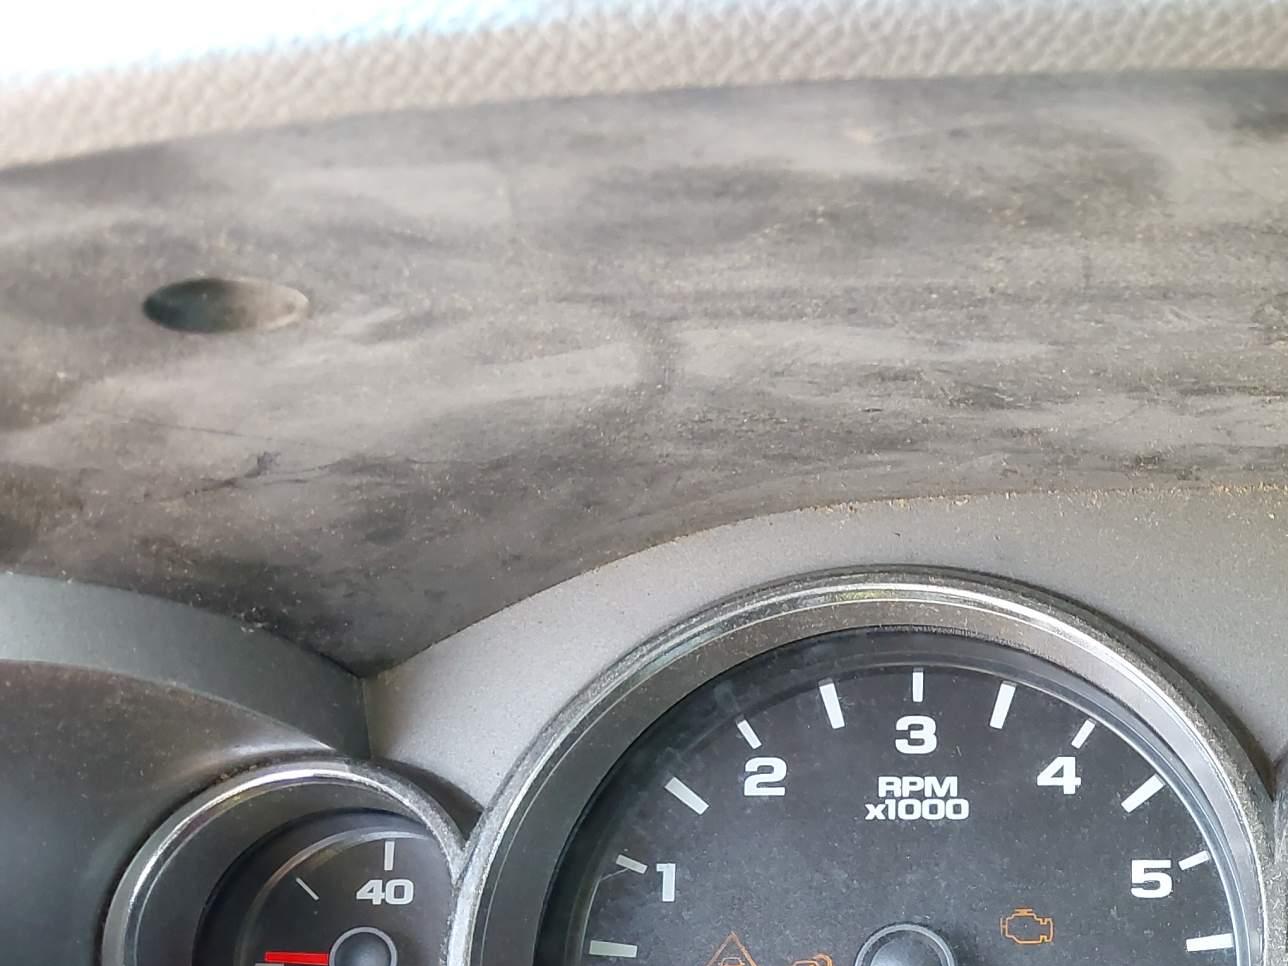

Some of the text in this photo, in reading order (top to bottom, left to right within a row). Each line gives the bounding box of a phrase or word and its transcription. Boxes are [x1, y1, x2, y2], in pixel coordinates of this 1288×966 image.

[894, 714, 938, 755] 3
[743, 756, 788, 797] 2
[878, 775, 959, 798] RPM
[1036, 755, 1082, 795] 4
[864, 797, 971, 821] x1000
[355, 877, 415, 905] 40
[655, 862, 677, 903] 1
[1130, 858, 1175, 899] 5
